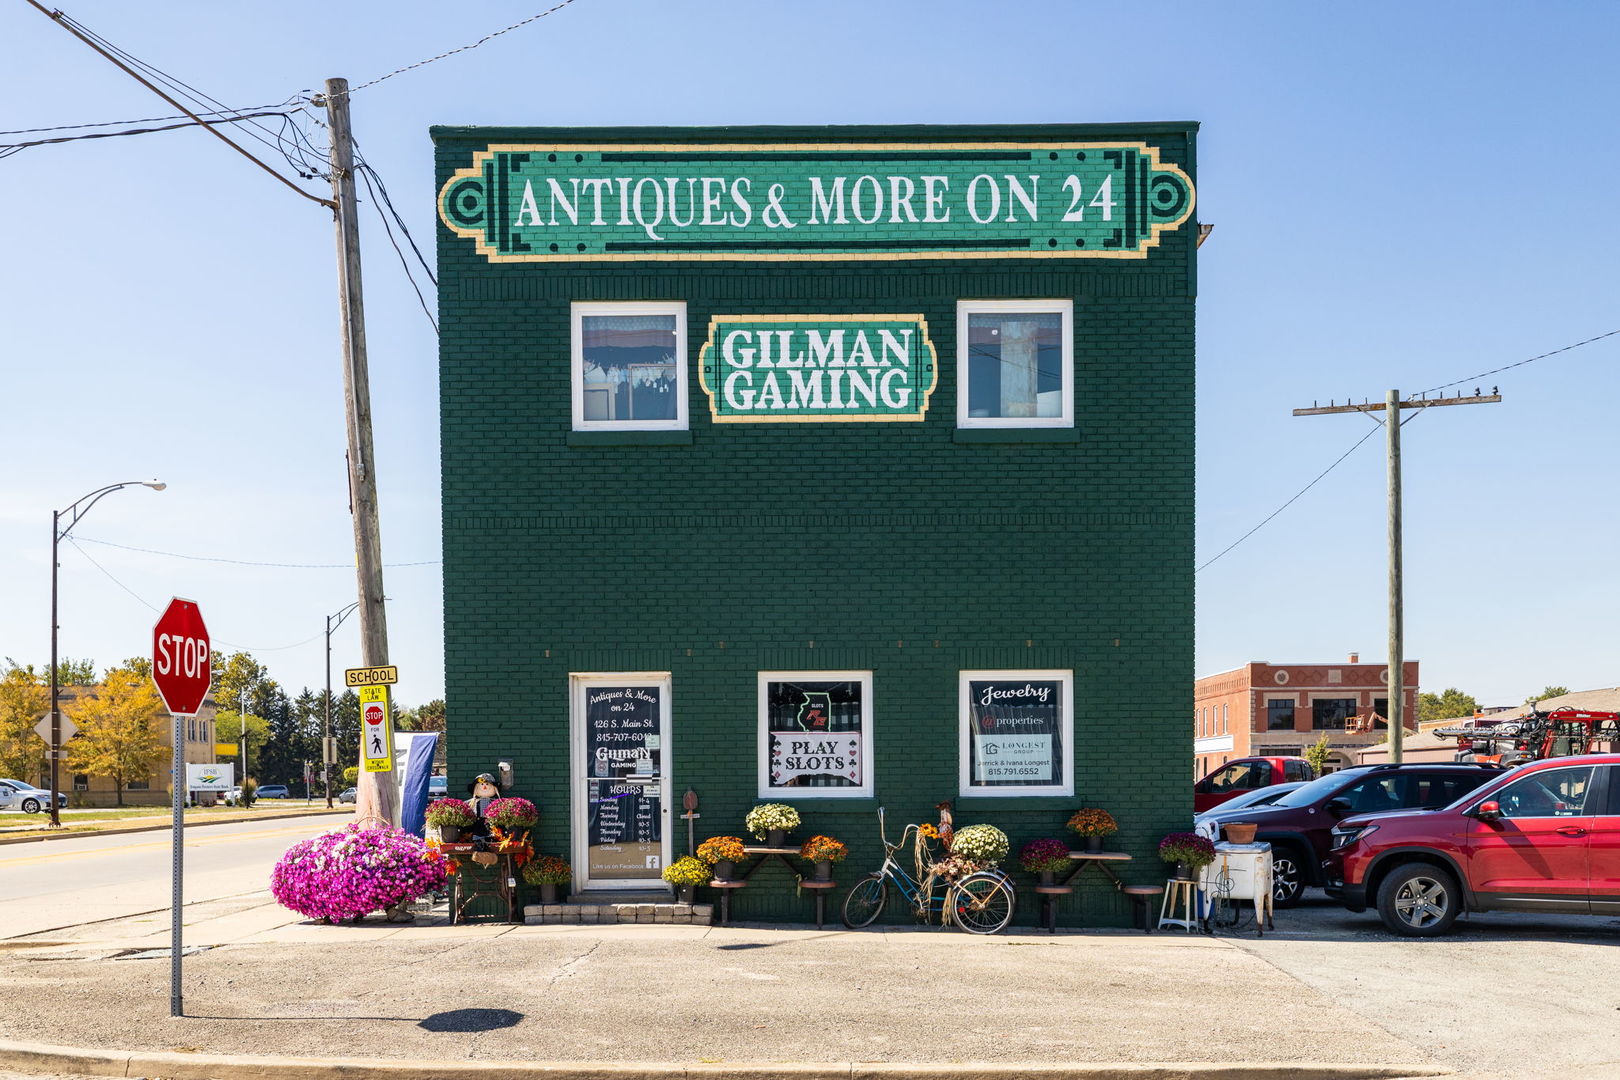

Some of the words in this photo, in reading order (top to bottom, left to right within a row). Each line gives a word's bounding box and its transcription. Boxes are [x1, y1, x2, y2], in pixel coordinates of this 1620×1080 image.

[514, 176, 752, 241] ANTIQUES
[762, 177, 798, 229] &
[807, 174, 951, 226] MORE
[966, 174, 1041, 225] ON
[1061, 173, 1118, 223] 24
[722, 328, 914, 370] GILMAN
[723, 368, 912, 411] GAMING
[157, 632, 208, 680] STOP
[349, 669, 394, 684] SCHOOL
[364, 687, 382, 695] STATE
[590, 691, 623, 704] Antiques
[624, 688, 633, 699] &
[634, 690, 657, 703] More
[980, 683, 1051, 706] Jewelry
[610, 704, 622, 712] on
[623, 702, 635, 712] 24
[365, 711, 383, 721] STOP
[594, 719, 609, 728] 126
[610, 719, 619, 728] S.
[621, 719, 642, 728] Main
[643, 718, 655, 728] St.
[996, 714, 1045, 728] properties
[791, 740, 839, 755] PLAY
[1002, 741, 1045, 749] LONGEST
[785, 756, 845, 770] SLOTS
[988, 767, 1040, 776] 815.791.6552
[609, 785, 642, 795] HOURS
[600, 804, 619, 812] Monday
